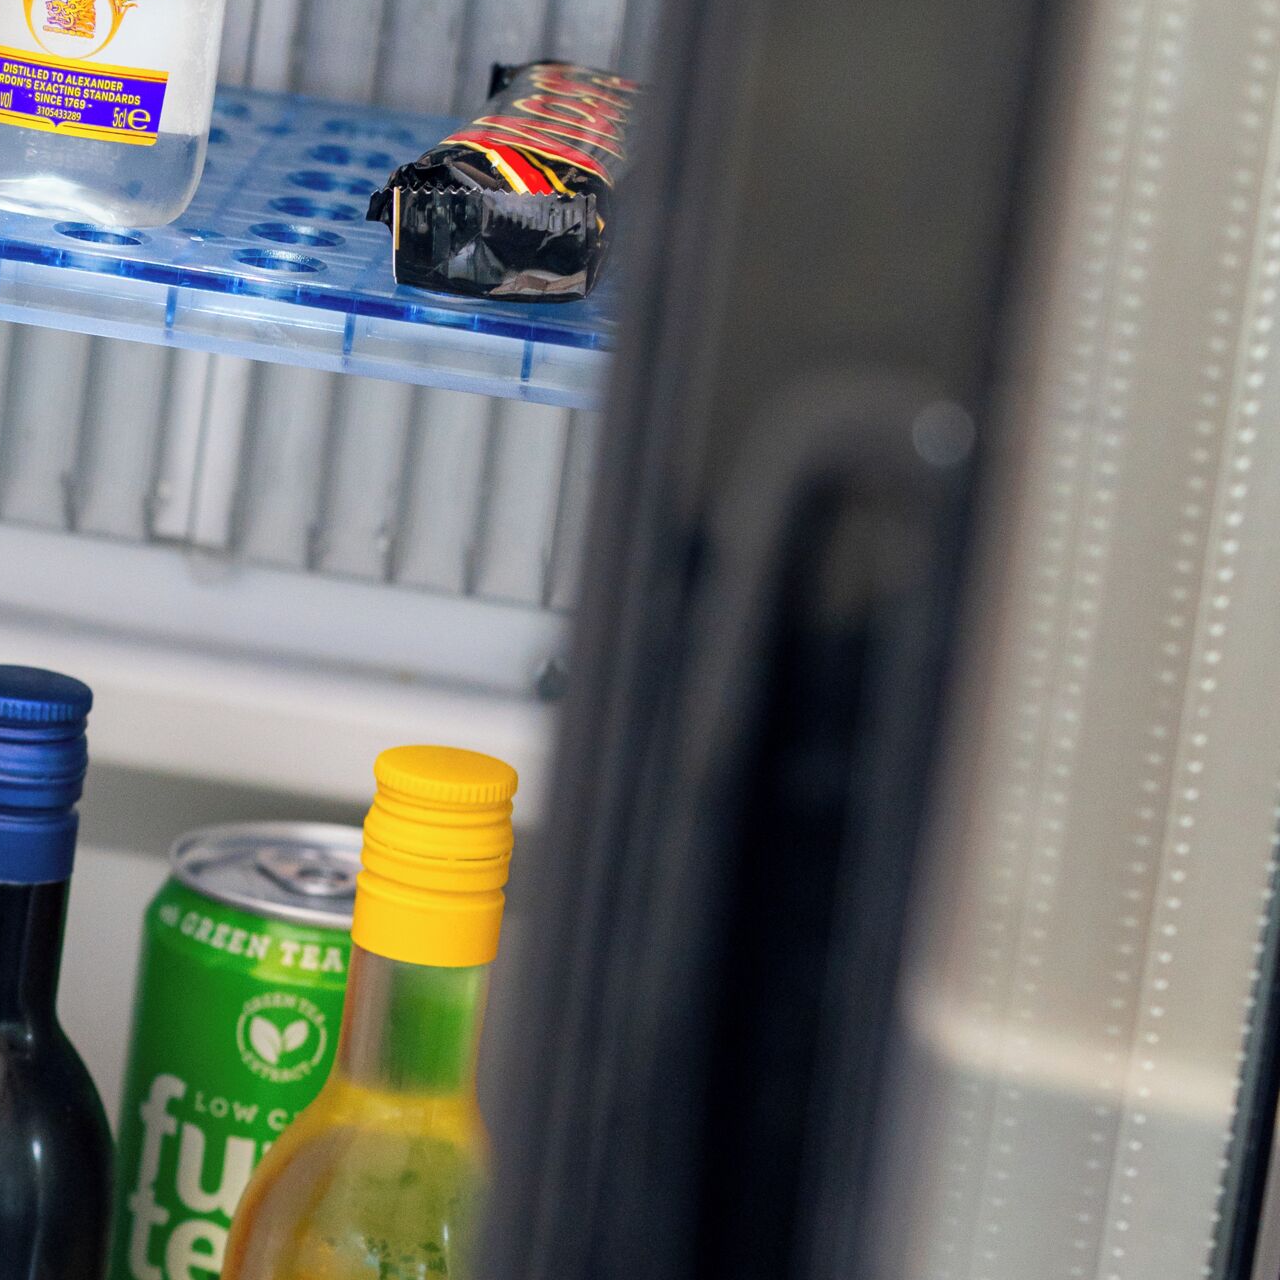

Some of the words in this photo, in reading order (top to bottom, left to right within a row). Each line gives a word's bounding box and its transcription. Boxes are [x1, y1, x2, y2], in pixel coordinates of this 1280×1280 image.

[3, 62, 50, 81] DISTILLED
[51, 71, 65, 82] TO
[65, 74, 124, 92] ALEXANDER
[0, 89, 13, 108] vol
[34, 81, 81, 98] EXACTING
[83, 89, 141, 106] STANDARDS
[34, 92, 62, 106] SINCE
[64, 96, 86, 110] 1769
[112, 107, 127, 128] 5cl
[180, 911, 271, 960] GREEN
[279, 939, 344, 973] TEA
[194, 1091, 259, 1125] LOW
